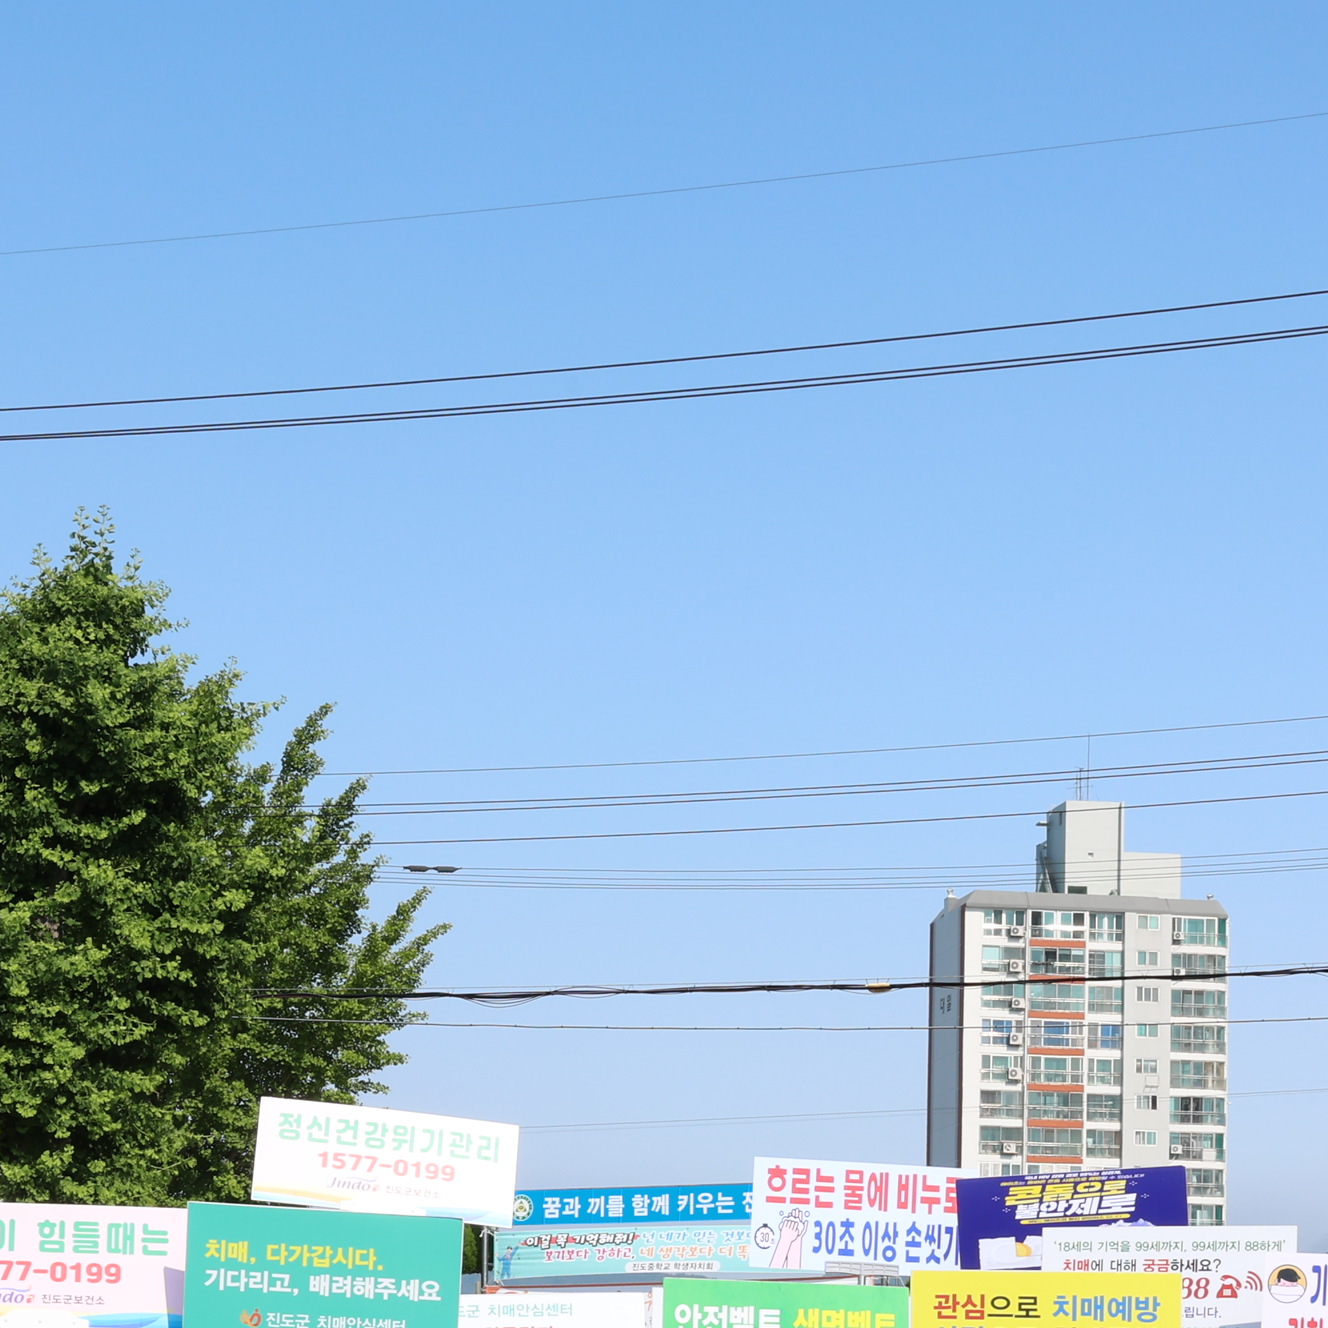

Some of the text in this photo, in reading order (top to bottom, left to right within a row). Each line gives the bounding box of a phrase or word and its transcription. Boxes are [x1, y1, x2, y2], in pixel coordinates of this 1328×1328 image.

[277, 1112, 501, 1163] 정신건강위기관리
[317, 1151, 457, 1182] 1577-0199
[766, 1165, 835, 1209] 흐르는
[844, 1169, 890, 1212] 물에
[897, 1173, 958, 1215] 비누로
[1005, 1180, 1127, 1206] 콘돔으로
[543, 1196, 581, 1219] 꿈과
[586, 1195, 625, 1218] 끼를
[631, 1194, 670, 1217] 함께
[677, 1192, 735, 1215] 키우는
[1015, 1193, 1137, 1220] 불안제로
[37, 1218, 170, 1256] 힘들때는
[526, 1233, 552, 1249] 이걸
[556, 1233, 569, 1249] 꼭
[812, 1218, 959, 1266] 30초 이상 손씻기
[204, 1239, 384, 1271] 치매, 다가갑시다.
[1063, 1258, 1223, 1274] 치매에 대해 궁금하세요?
[41, 1293, 105, 1306] 진도군보건소
[203, 1268, 442, 1302] 기다리고, 배려해주세요
[488, 1302, 574, 1318] 치매안심센터
[932, 1294, 1161, 1324] 관심으로 치매예방
